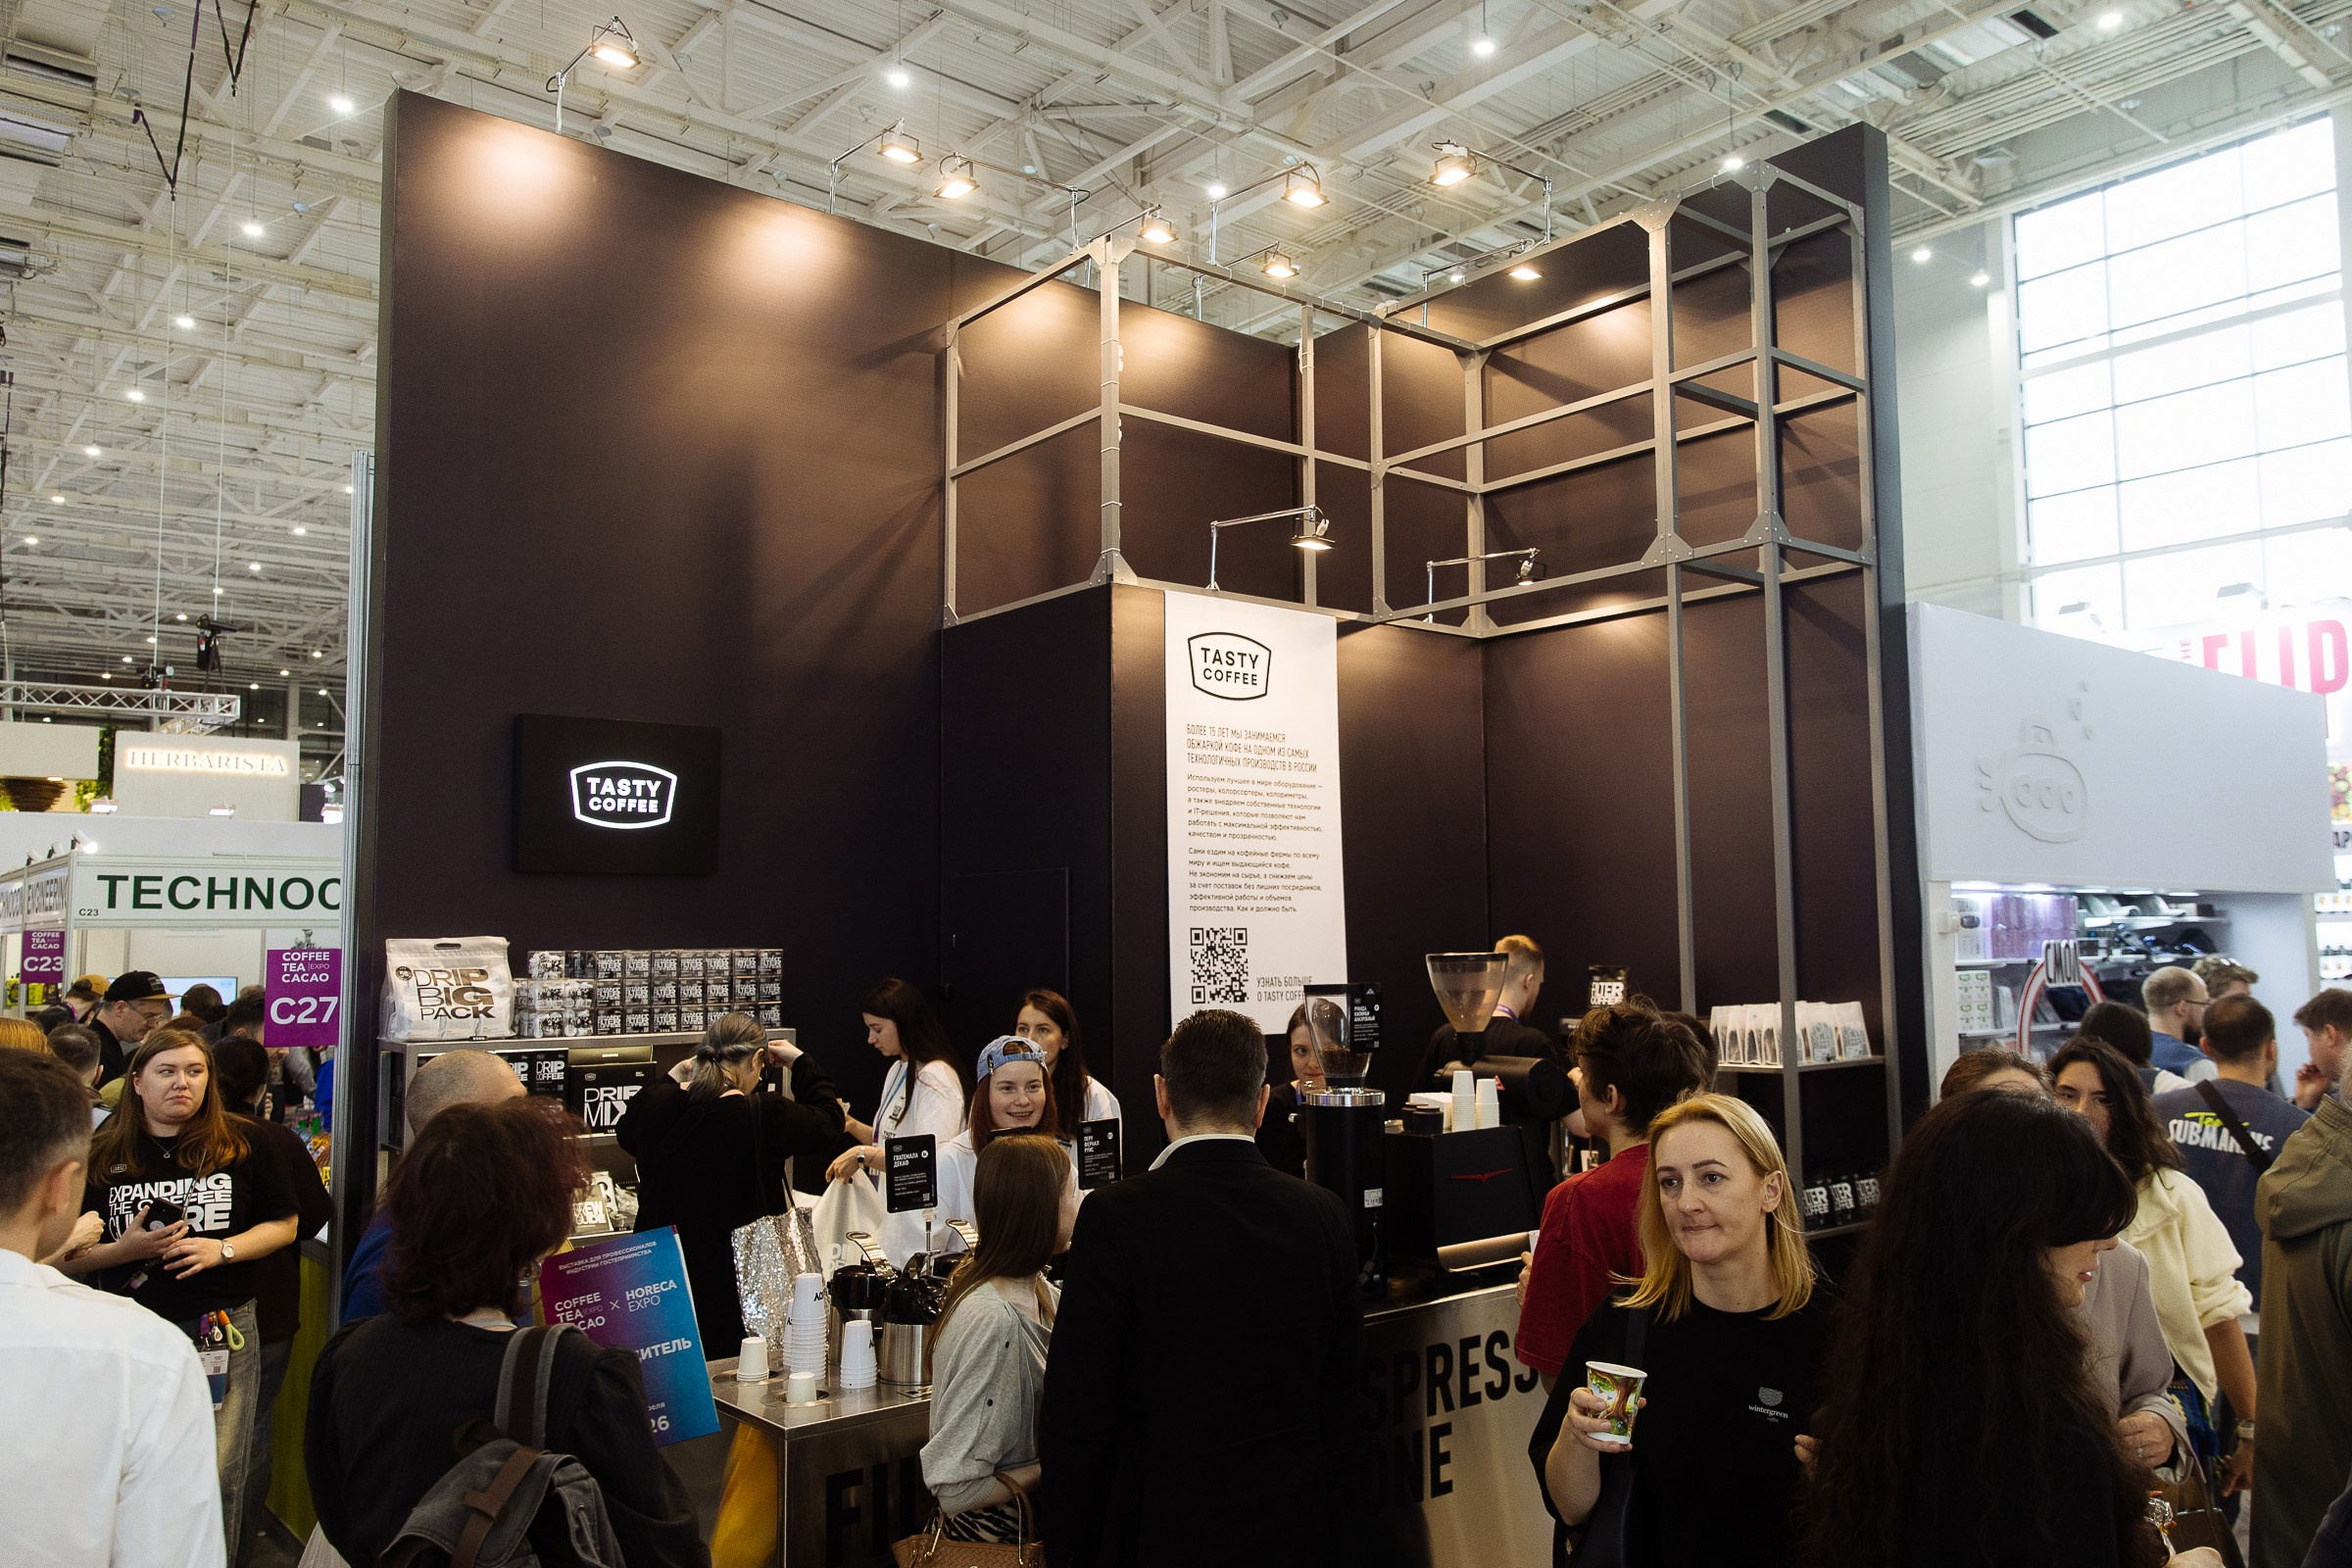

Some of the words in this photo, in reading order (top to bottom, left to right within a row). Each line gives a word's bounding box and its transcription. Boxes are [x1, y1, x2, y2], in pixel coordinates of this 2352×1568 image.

[1201, 647, 1259, 669] TASTY
[1203, 668, 1258, 686] COFFEE
[1187, 724, 1206, 735] БОЛЕЕ
[1209, 727, 1216, 736] 15
[1218, 727, 1228, 738] ЛЕТ
[1231, 729, 1242, 739] МЫ
[1245, 730, 1286, 743] ЗАНИМАЕМСЯ
[1187, 738, 1222, 751] ОБЖАРКОЙ
[1225, 743, 1241, 753] КОФЕ
[1244, 744, 1252, 754] НА
[1254, 745, 1275, 756] ОДНОМ
[1278, 747, 1285, 757] ИЗ
[1287, 748, 1309, 759] САМЫХ
[130, 751, 285, 772] HERBARISTA
[1187, 753, 1241, 767] ТЕХНОЛОГИЧНЫХ
[1243, 757, 1286, 771] ПРОИЗВОДСТВ
[1288, 761, 1292, 771] В
[1294, 762, 1317, 772] РОССИИ
[587, 777, 661, 797] TASTY
[1187, 774, 1225, 782] Используем
[1274, 781, 1316, 789] оборудование
[1218, 789, 1264, 797] колорсортеры,
[588, 797, 658, 813] COFFEE
[1193, 808, 1231, 817] IT-решения,
[1270, 823, 1322, 833] эффективностью,
[23, 956, 64, 972] C23
[282, 952, 330, 961] COFFEE
[282, 963, 306, 972] TEA
[282, 973, 329, 983] CACAO
[413, 969, 489, 987] DRIP
[1257, 977, 1282, 987] УЗНАТЬ
[1284, 976, 1312, 987] БОЛЬШЕ
[417, 986, 494, 1007] BIG
[1257, 992, 1262, 1002] О
[1264, 991, 1284, 1001] TASTY
[1286, 991, 1305, 1001] COFFE
[1591, 982, 1624, 997] FILTER
[1590, 996, 1623, 1005] COFFEE
[270, 996, 338, 1025] C27
[420, 1006, 496, 1021] PACK
[536, 1061, 565, 1074] DRIP
[536, 1072, 564, 1081] COFFEE
[584, 1085, 643, 1102] DRIP
[893, 1153, 919, 1161] ГВАТЕМАЛА
[109, 1173, 232, 1203] EXPANDING
[109, 1201, 133, 1216] THE
[137, 1190, 232, 1211] CFFEE
[109, 1202, 232, 1241] CURE
[558, 1259, 589, 1271] ВЫСТАВКА
[602, 1241, 657, 1259] ПРОФЕССИОНАЛОВ
[566, 1263, 599, 1275] ИНДУСТРИИ
[600, 1249, 652, 1266] ГОСТЕПРИИМСТВА
[626, 1279, 677, 1301] HORECA
[554, 1292, 601, 1312] COFFEE
[628, 1295, 661, 1312] EXPO
[556, 1308, 583, 1324] TEA
[585, 1304, 603, 1315] EXPO
[578, 1315, 606, 1331] CAO
[1748, 1404, 1789, 1419] wintergreen
